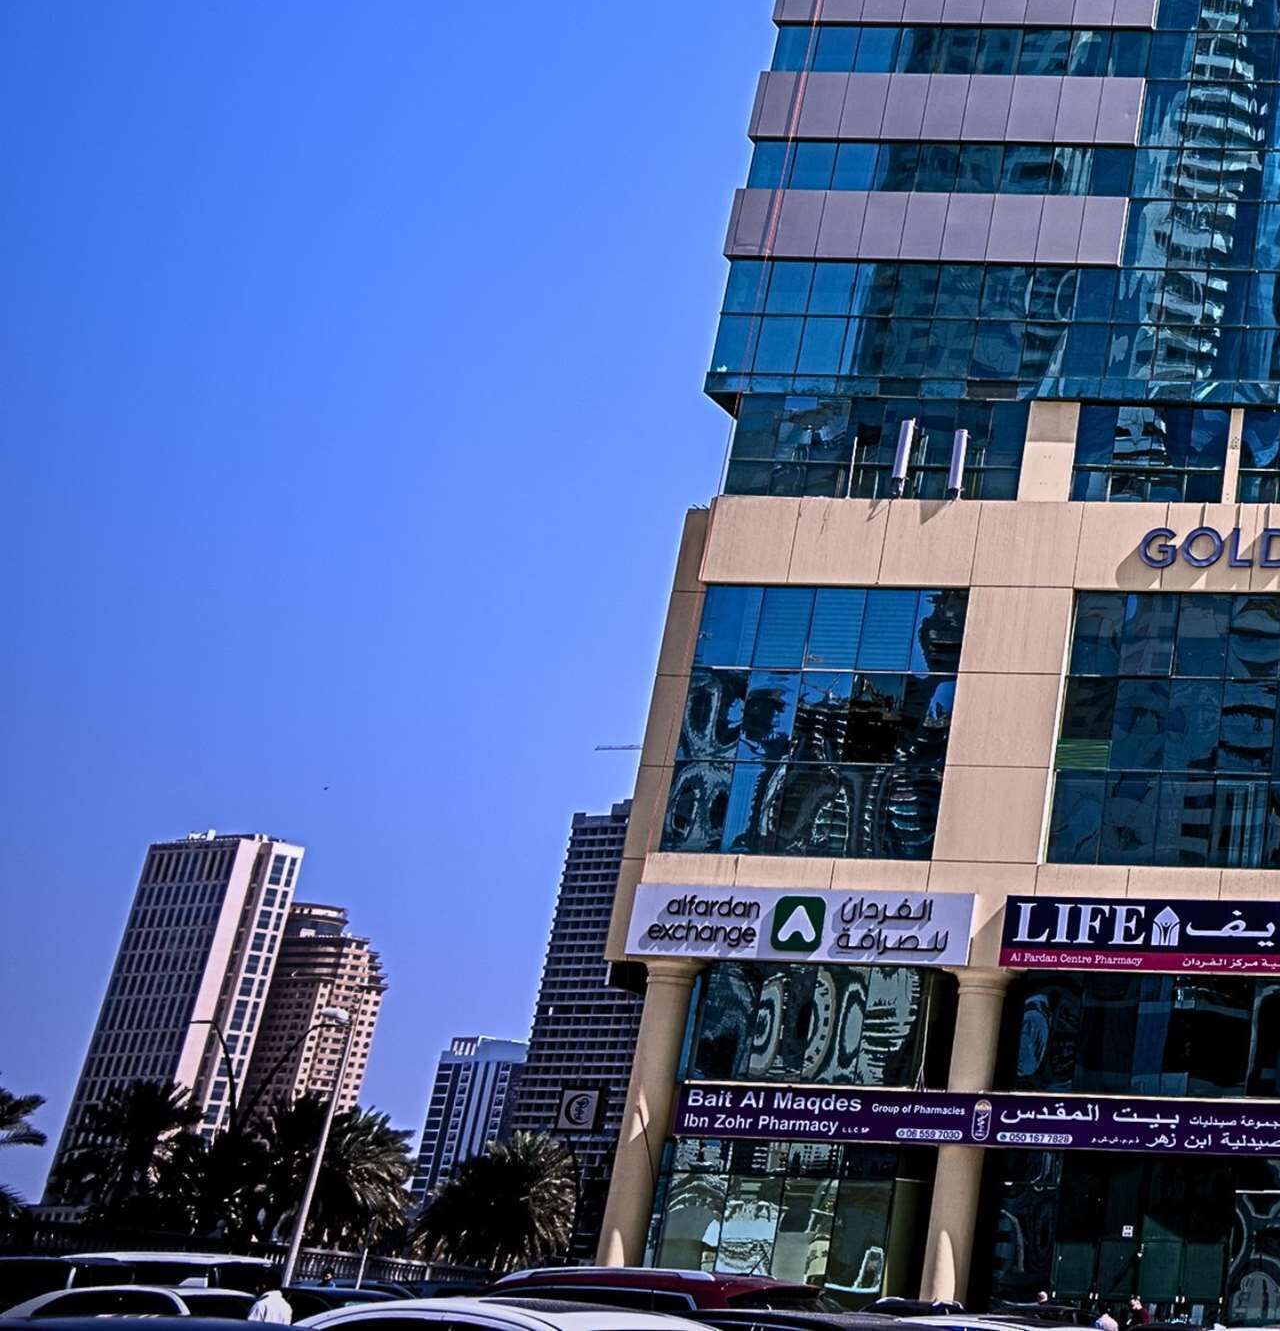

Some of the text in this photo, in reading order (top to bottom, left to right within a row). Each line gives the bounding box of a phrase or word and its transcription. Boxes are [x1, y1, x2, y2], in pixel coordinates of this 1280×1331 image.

[666, 894, 760, 919] alfardan
[841, 896, 933, 924] الفردان
[649, 920, 757, 947] exchange
[1013, 903, 1146, 945] LIFE
[836, 927, 949, 955] للصرافة
[1010, 953, 1142, 967] Al Fardan Centre Pharmacy
[1182, 958, 1227, 968] الفردان
[1228, 958, 1259, 969] مركز
[688, 1090, 862, 1115] Bait Al Maqdes
[872, 1103, 966, 1116] Group of Pharmacies
[684, 1113, 708, 1128] Ibn
[714, 1114, 752, 1129] Zohr
[758, 1115, 838, 1135] Pharmacy
[1000, 1102, 1180, 1129] بيت المقدس
[1189, 1115, 1237, 1127] صيدليات
[1145, 1133, 1177, 1148] زهر
[1184, 1132, 1212, 1148] ابن
